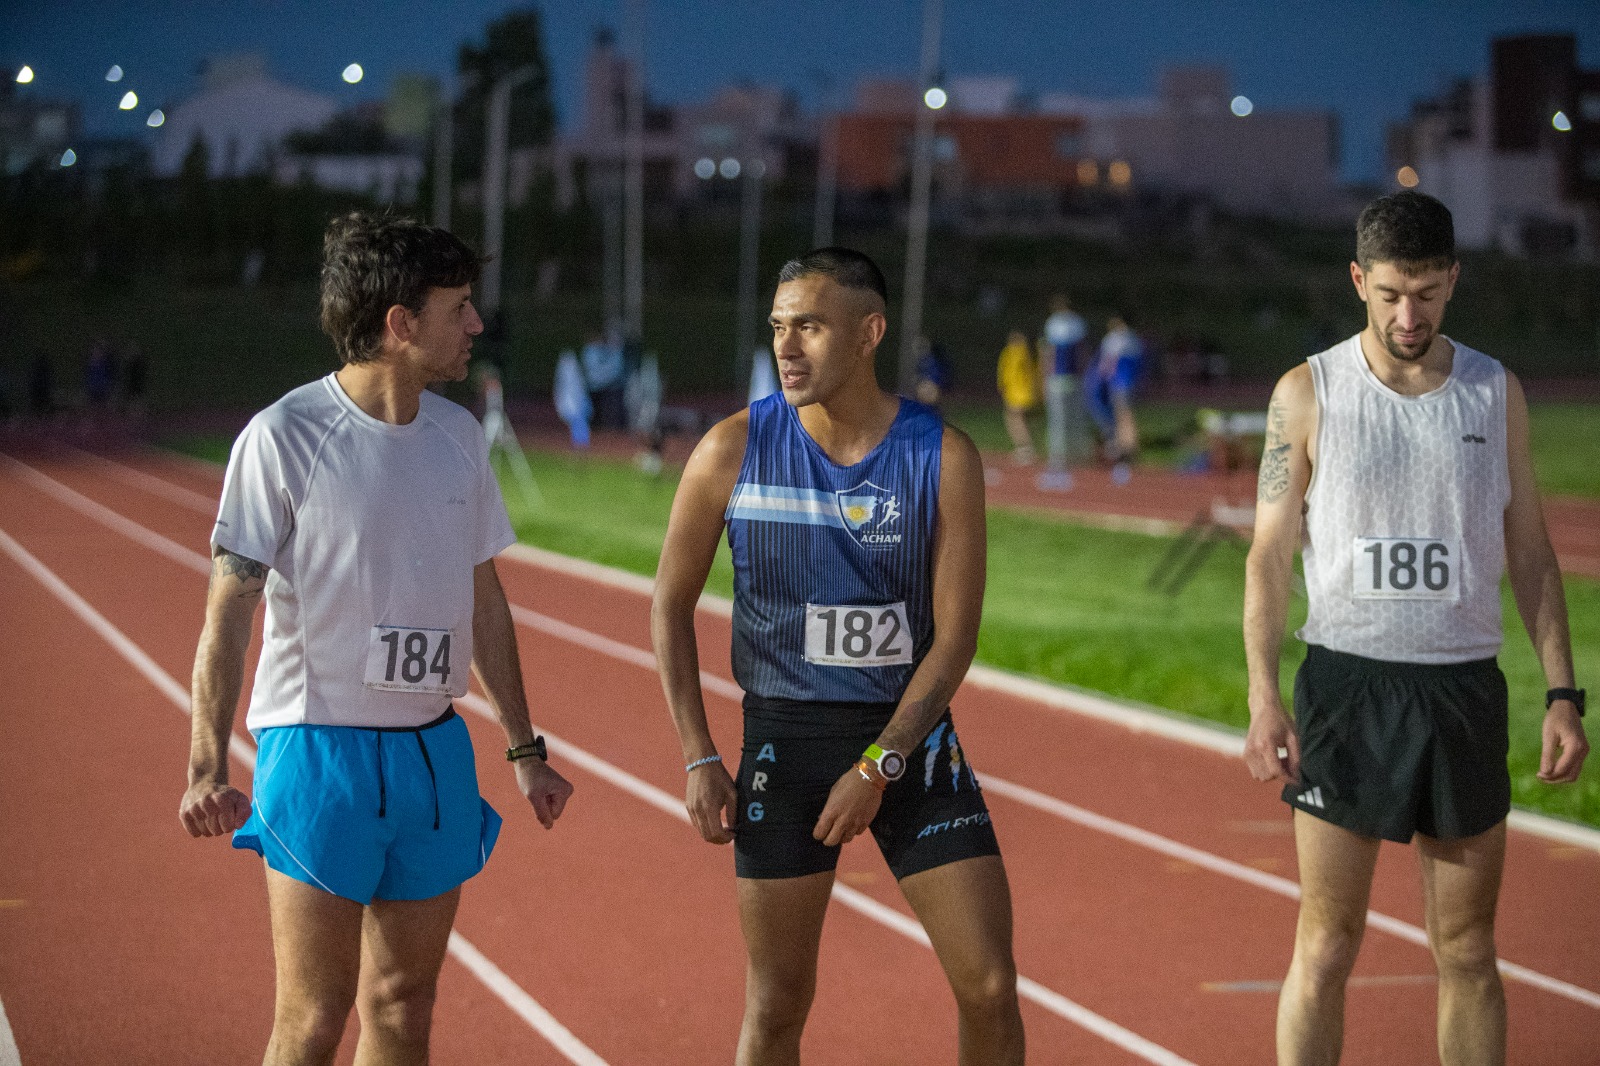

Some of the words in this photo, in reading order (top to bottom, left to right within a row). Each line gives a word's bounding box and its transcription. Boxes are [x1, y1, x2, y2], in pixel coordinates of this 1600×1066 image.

[860, 534, 902, 543] ACHAM
[1363, 541, 1450, 591] 186
[380, 630, 451, 685] 184
[817, 608, 902, 658] 182
